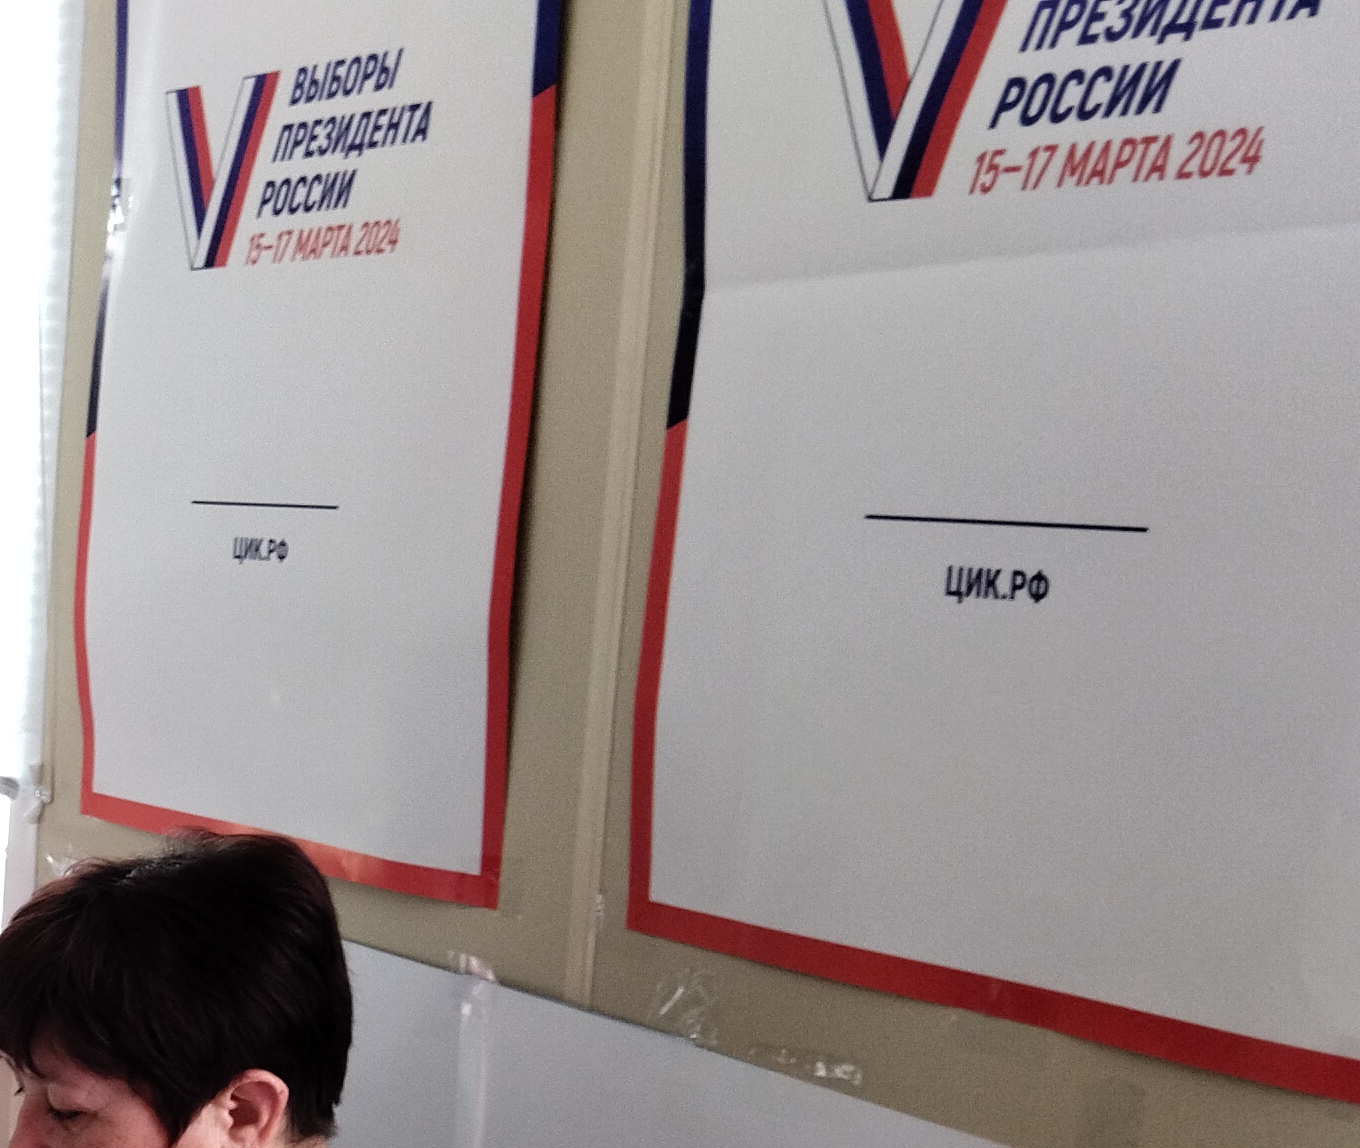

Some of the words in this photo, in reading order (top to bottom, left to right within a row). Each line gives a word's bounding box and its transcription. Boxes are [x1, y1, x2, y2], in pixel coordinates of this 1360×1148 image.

[288, 47, 404, 108] ВЫБОРЫ
[988, 57, 1183, 130] РОССИИ
[272, 101, 433, 163] ПРЕЗИДЕНТА
[969, 145, 1055, 195] 15–17
[1058, 135, 1173, 189] МАРТА
[1177, 127, 1264, 181] 2024
[256, 170, 356, 218] РОССИИ
[245, 230, 293, 266] 15–17
[293, 222, 354, 263] МАРТА
[353, 217, 401, 257] 2024
[233, 537, 288, 563] ЦИК.РФ
[945, 565, 1050, 604] ЦИК.РФ
